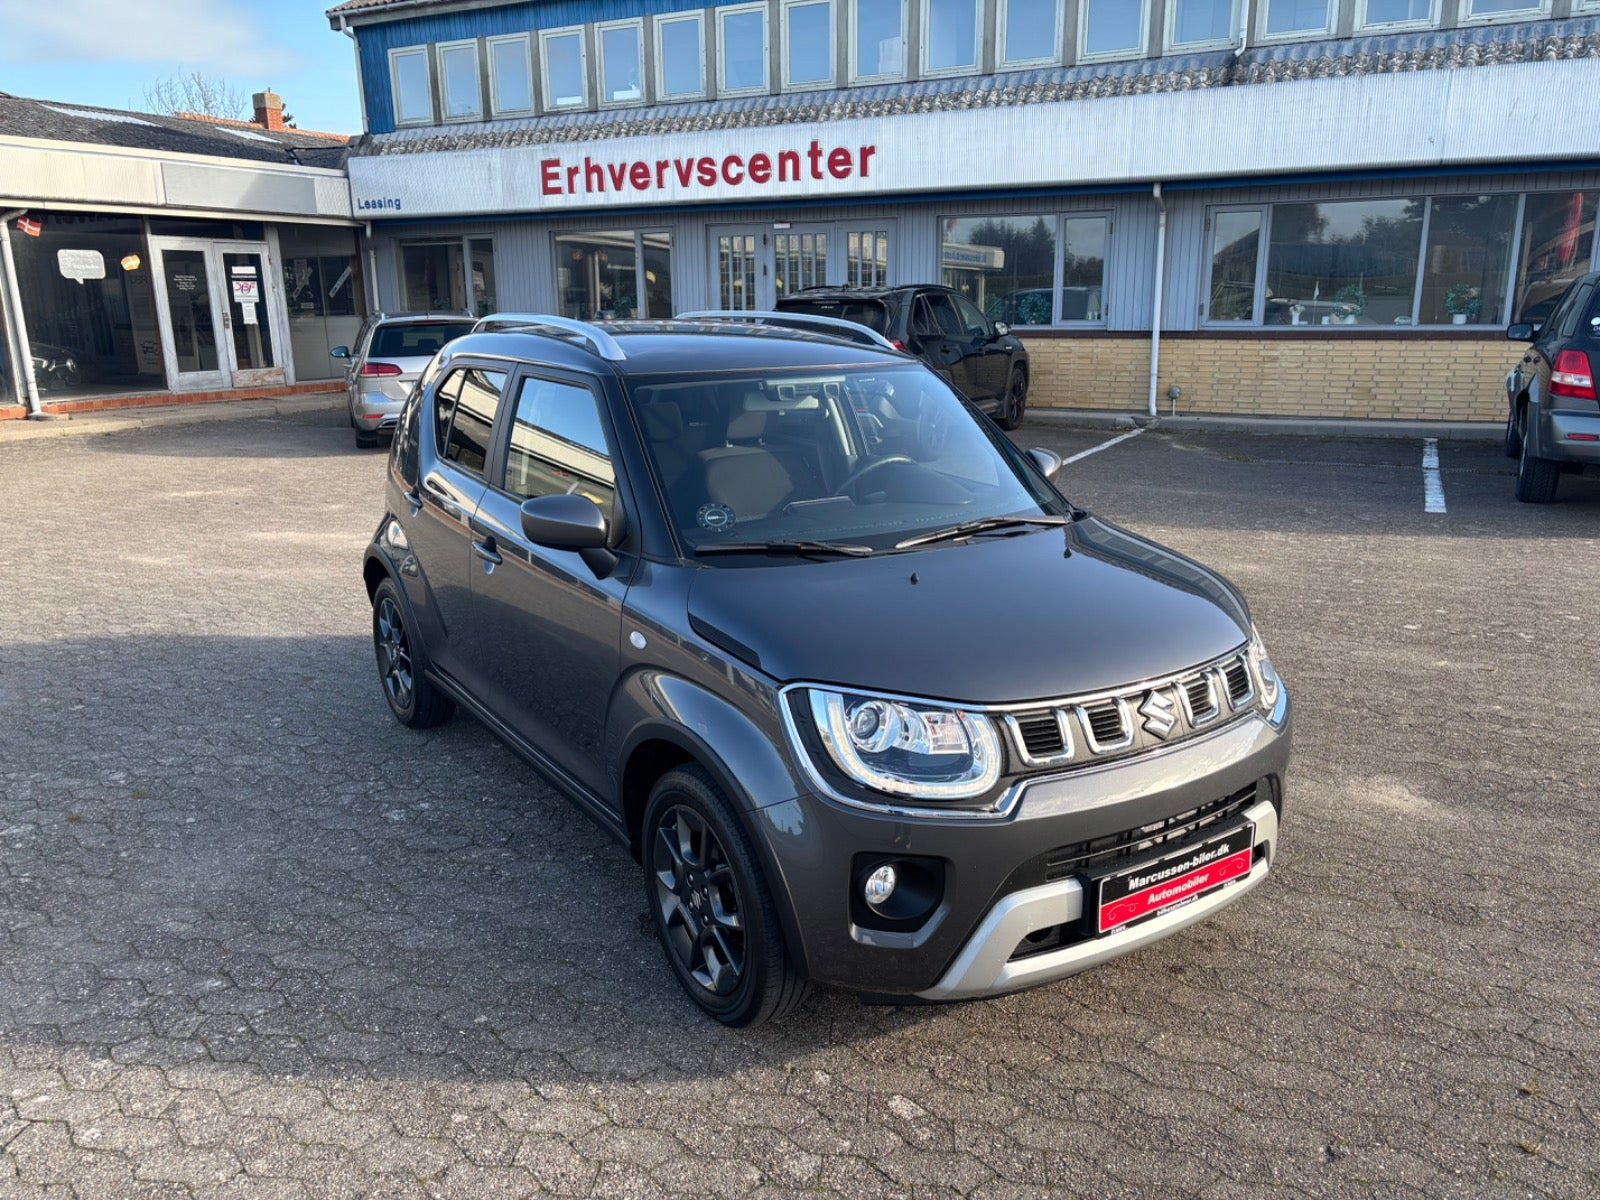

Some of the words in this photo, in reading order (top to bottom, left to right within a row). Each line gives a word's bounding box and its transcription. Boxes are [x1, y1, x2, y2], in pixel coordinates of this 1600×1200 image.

[540, 139, 876, 195] Erhvervscenter
[357, 197, 401, 210] Leasing
[1128, 843, 1230, 891] Marcussen-biler.dk
[1147, 873, 1210, 905] Automobiler
